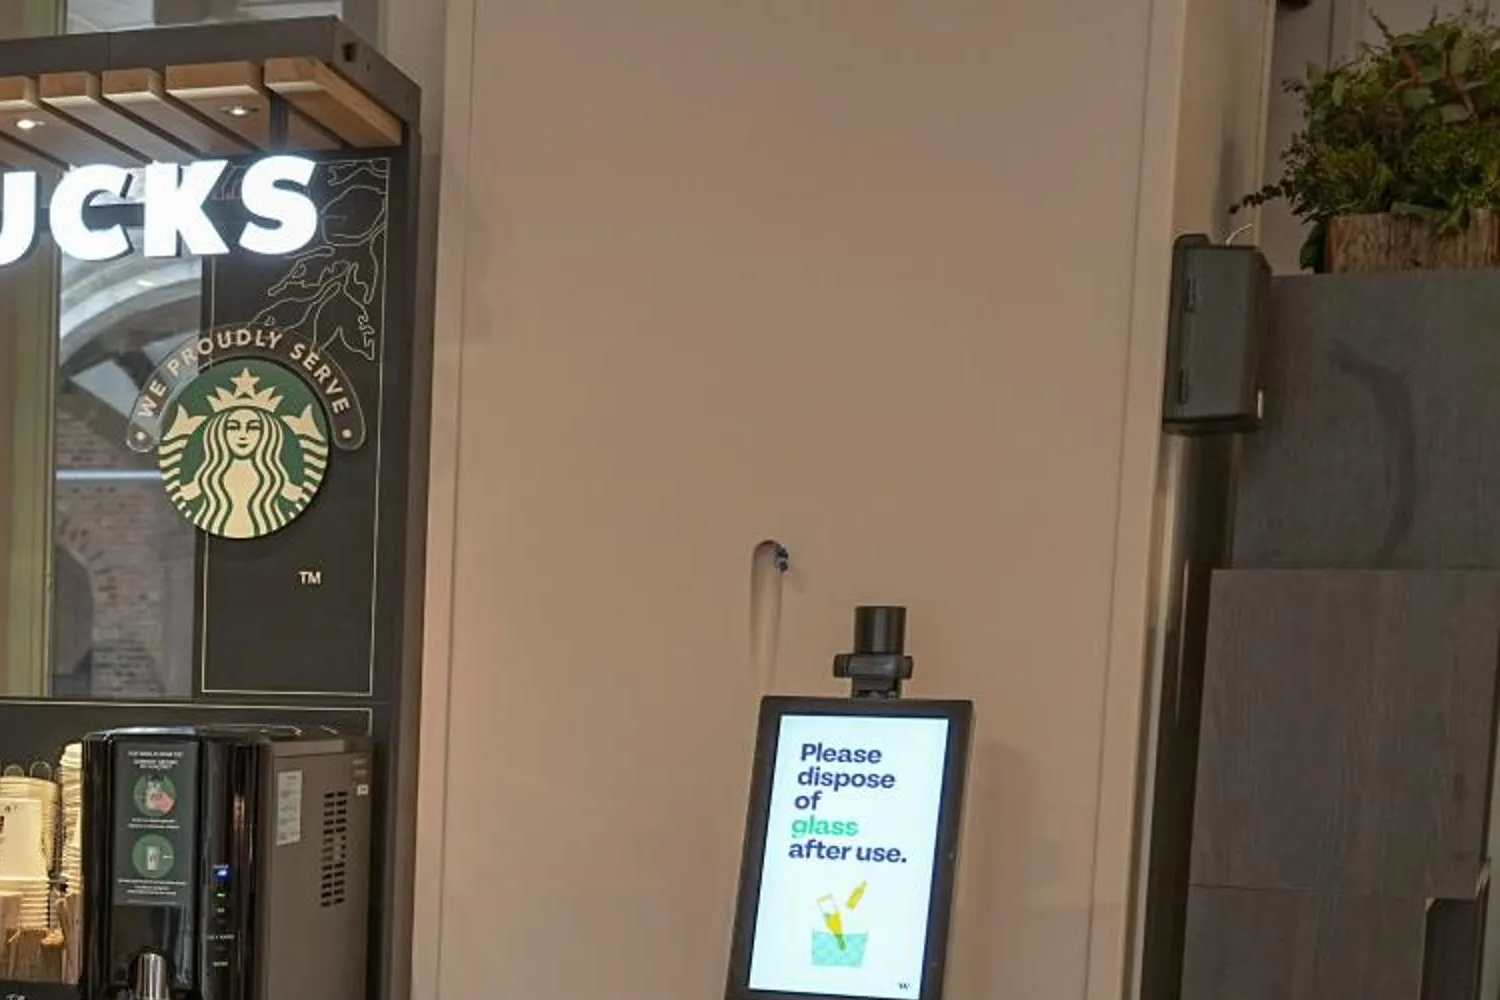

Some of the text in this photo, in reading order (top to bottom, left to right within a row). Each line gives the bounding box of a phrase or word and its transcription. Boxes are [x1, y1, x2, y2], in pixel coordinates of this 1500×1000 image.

[137, 328, 351, 418] WE PROUDLY SERVE
[299, 570, 321, 585] TM
[800, 742, 882, 764] Please
[797, 766, 896, 792] dispose
[794, 790, 823, 811] of
[791, 814, 859, 839] glass
[788, 838, 908, 864] after use.
